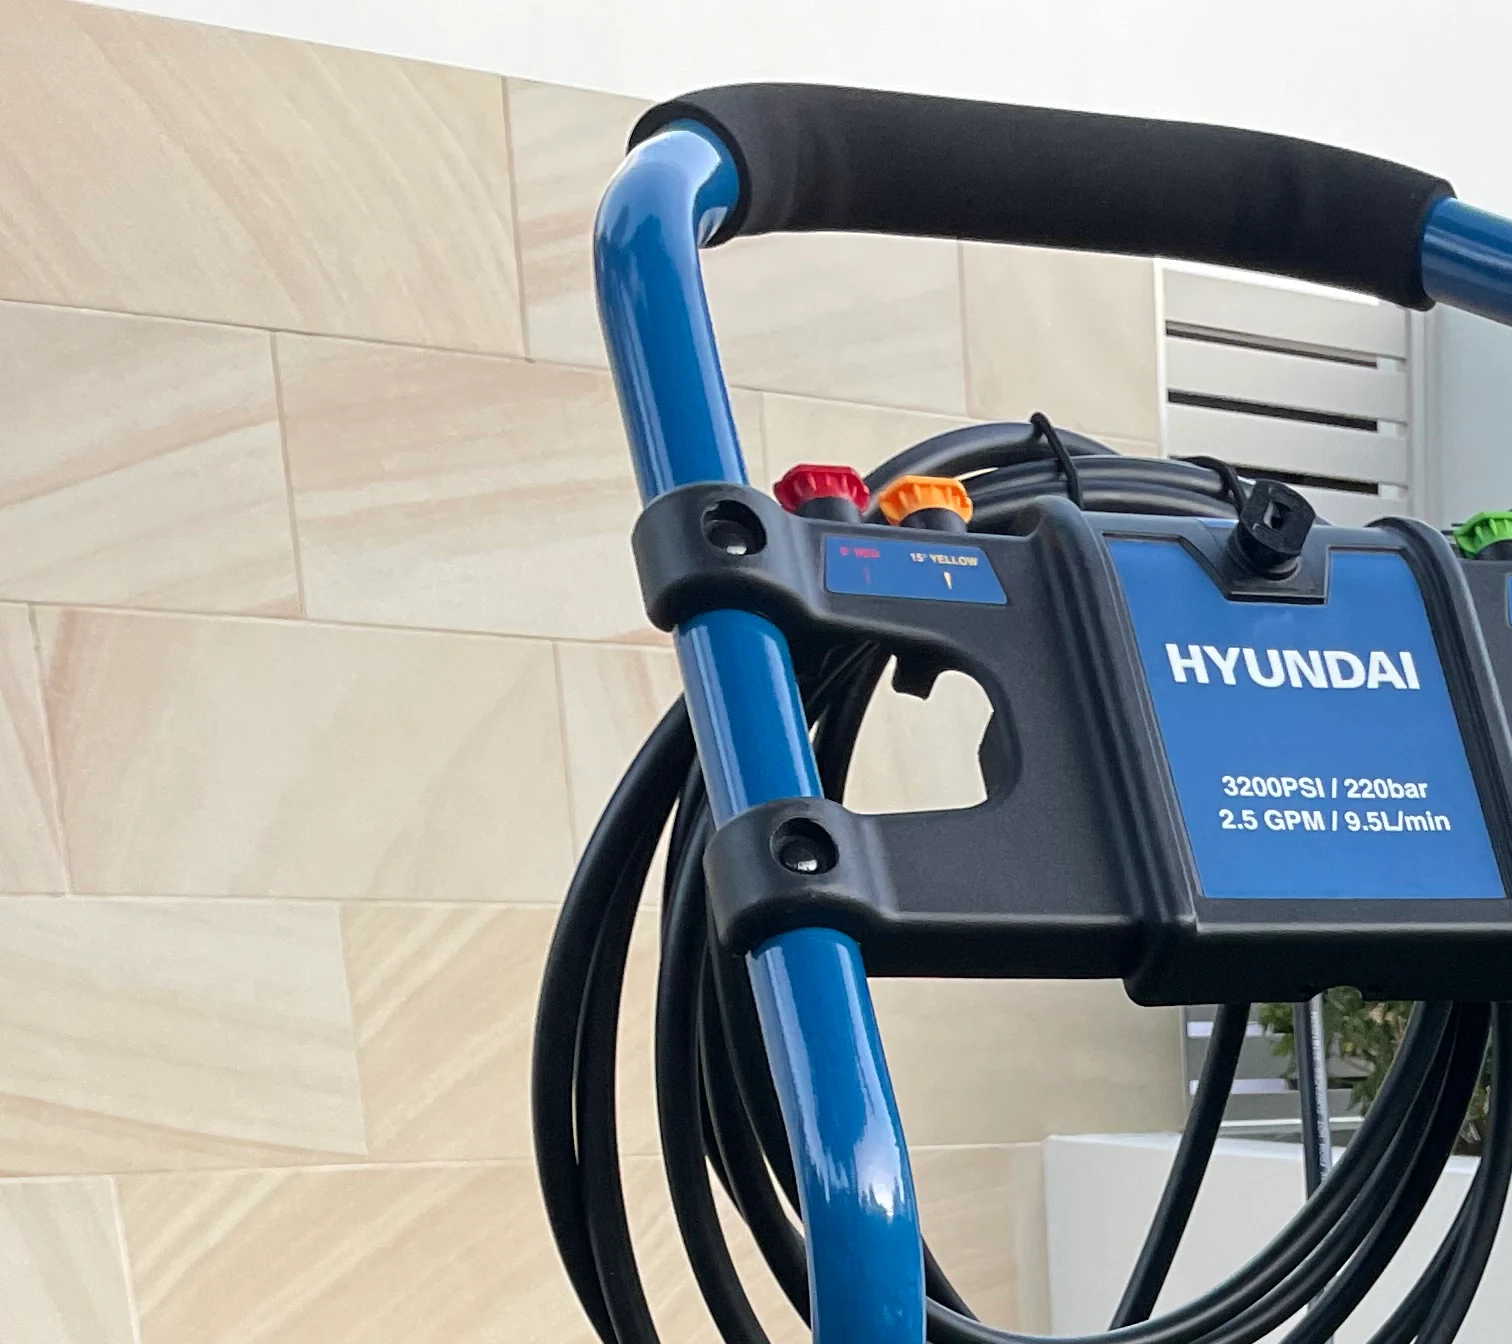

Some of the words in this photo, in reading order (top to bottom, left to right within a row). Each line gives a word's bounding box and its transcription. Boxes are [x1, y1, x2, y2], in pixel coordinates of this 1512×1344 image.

[929, 553, 979, 567] YELLOW
[1165, 643, 1421, 690] HYUNDAI
[1221, 775, 1326, 799] 3200PSI
[1343, 778, 1428, 799] 220bar
[1218, 808, 1258, 831] 2.5
[1263, 809, 1326, 832] GPM
[1344, 810, 1452, 832] 9.5L/min
